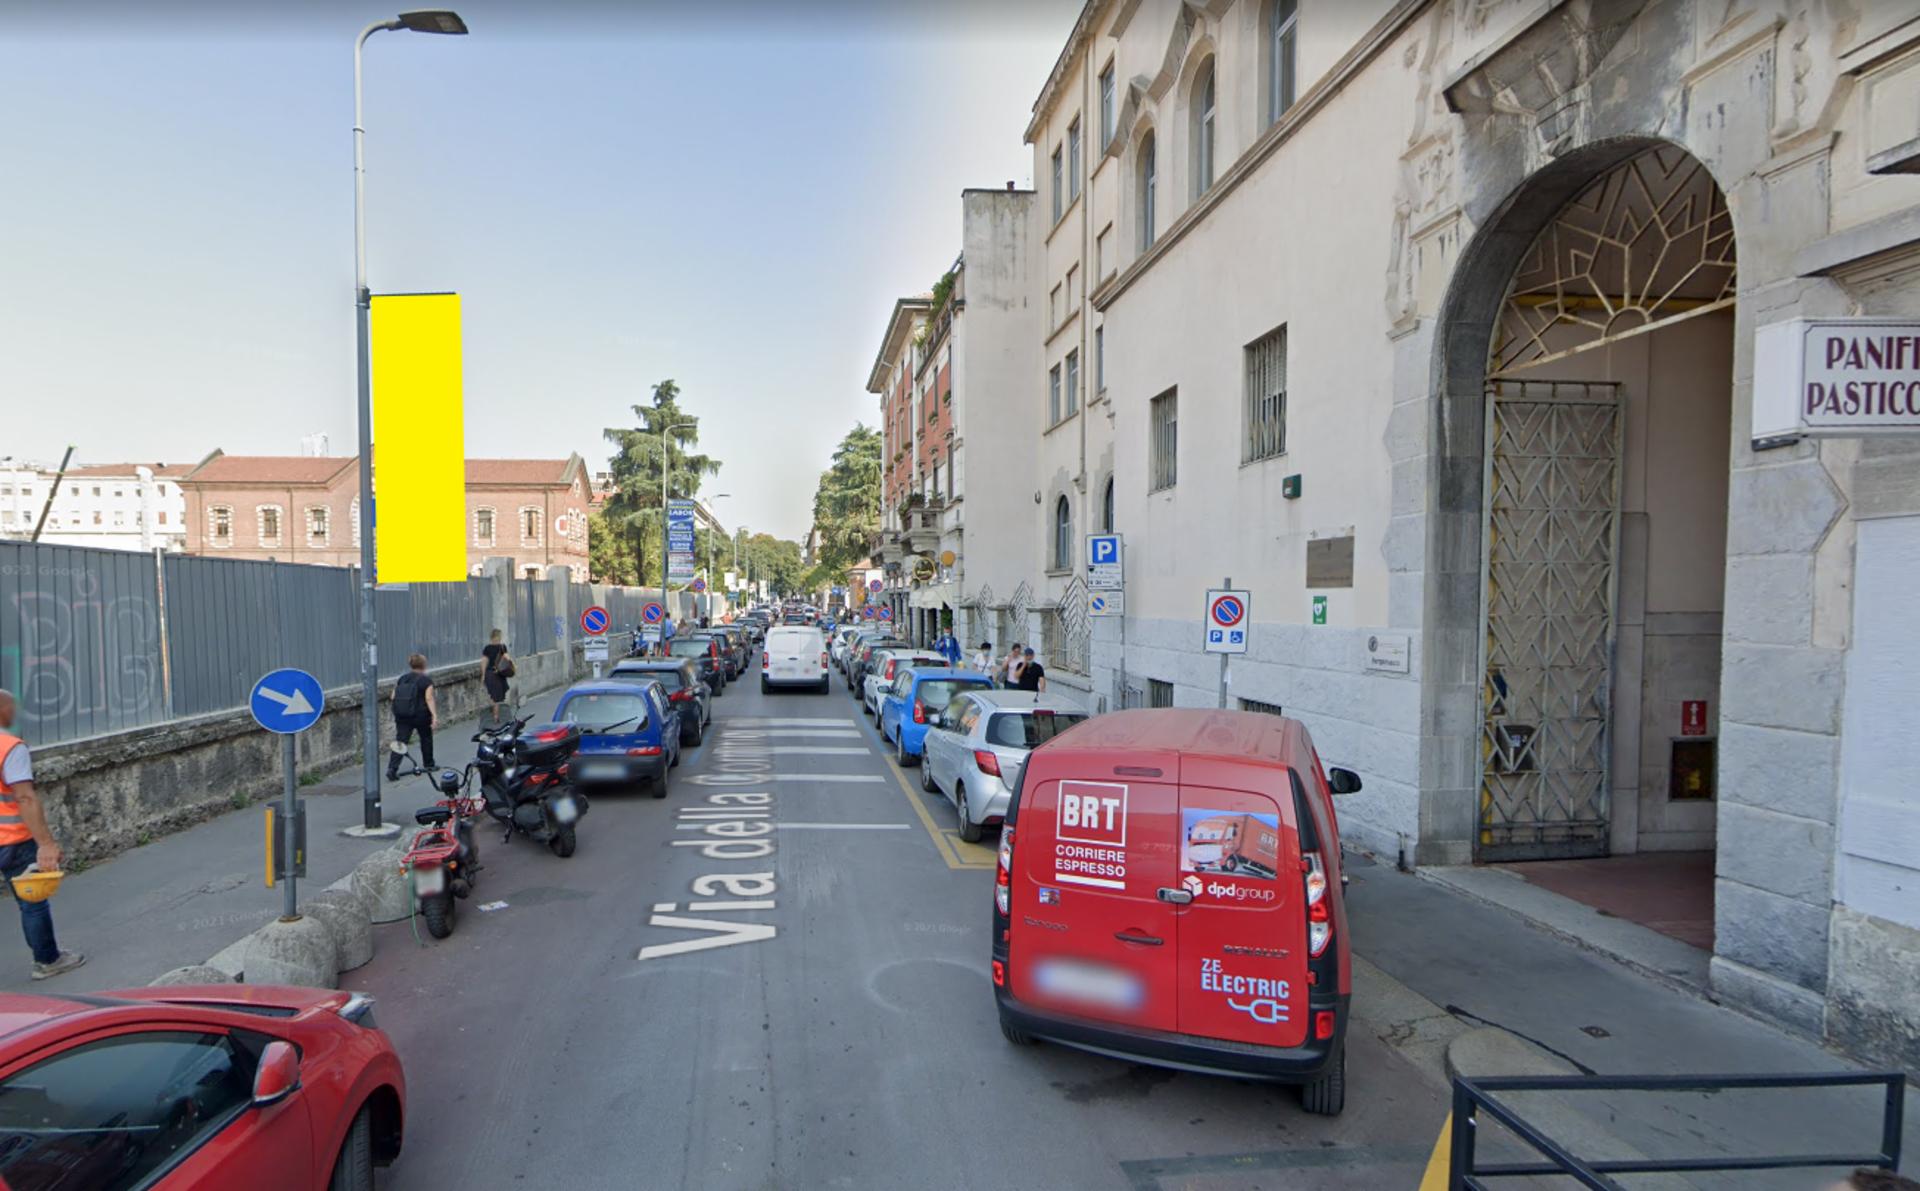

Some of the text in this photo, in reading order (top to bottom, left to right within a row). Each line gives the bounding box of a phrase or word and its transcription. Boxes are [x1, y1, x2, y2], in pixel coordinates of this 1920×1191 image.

[1096, 540, 1113, 561] P
[1063, 794, 1120, 832] BRT
[671, 792, 777, 860] della
[1056, 844, 1126, 863] CORRIERE
[1055, 858, 1126, 877] ESPRESSO
[1207, 881, 1276, 902] dpdgroup
[638, 871, 777, 961] Via
[1201, 972, 1290, 1000] ELECTRIC
